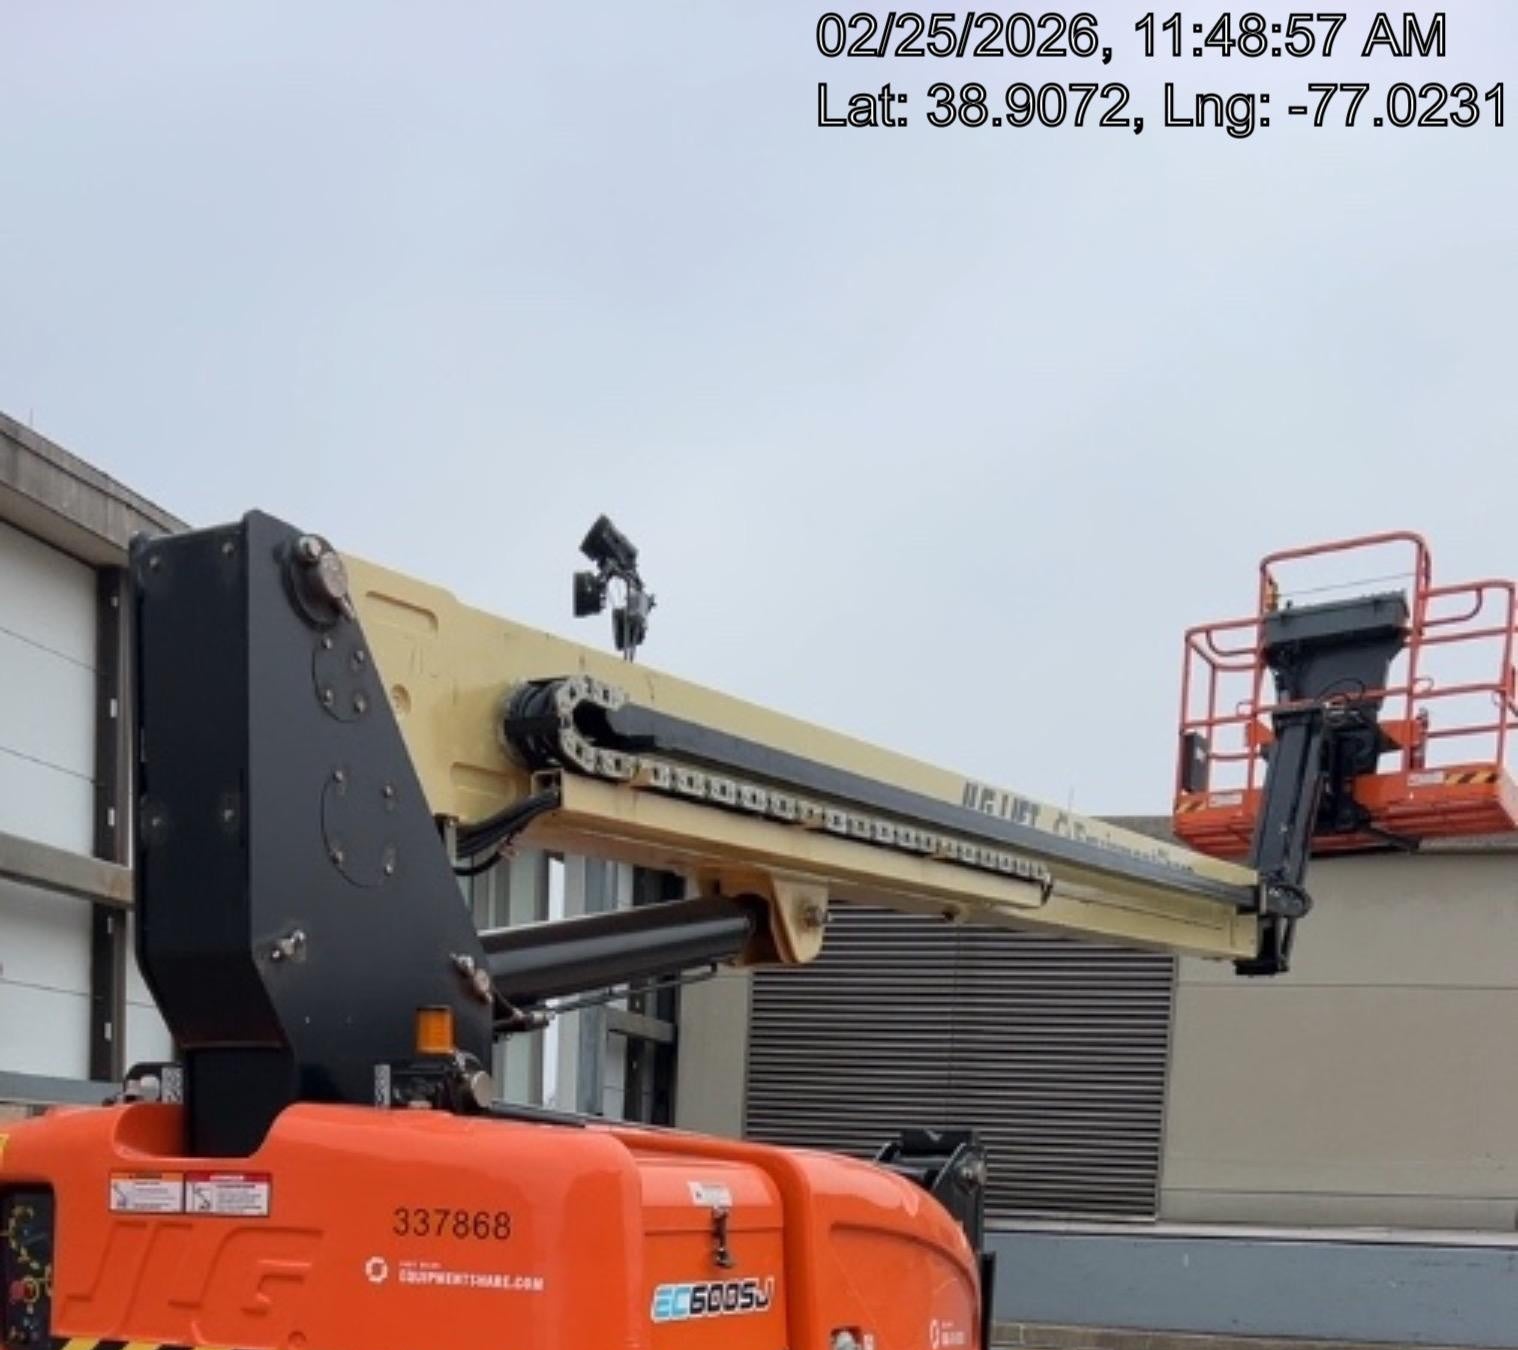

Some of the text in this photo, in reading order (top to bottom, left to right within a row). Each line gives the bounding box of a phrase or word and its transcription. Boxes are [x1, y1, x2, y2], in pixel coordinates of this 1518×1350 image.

[393, 1207, 512, 1241] 337868
[55, 1219, 323, 1348] JLG
[399, 1267, 544, 1291] EQUIPMENTSHARE.COM
[653, 1277, 774, 1322] EC600SJ
